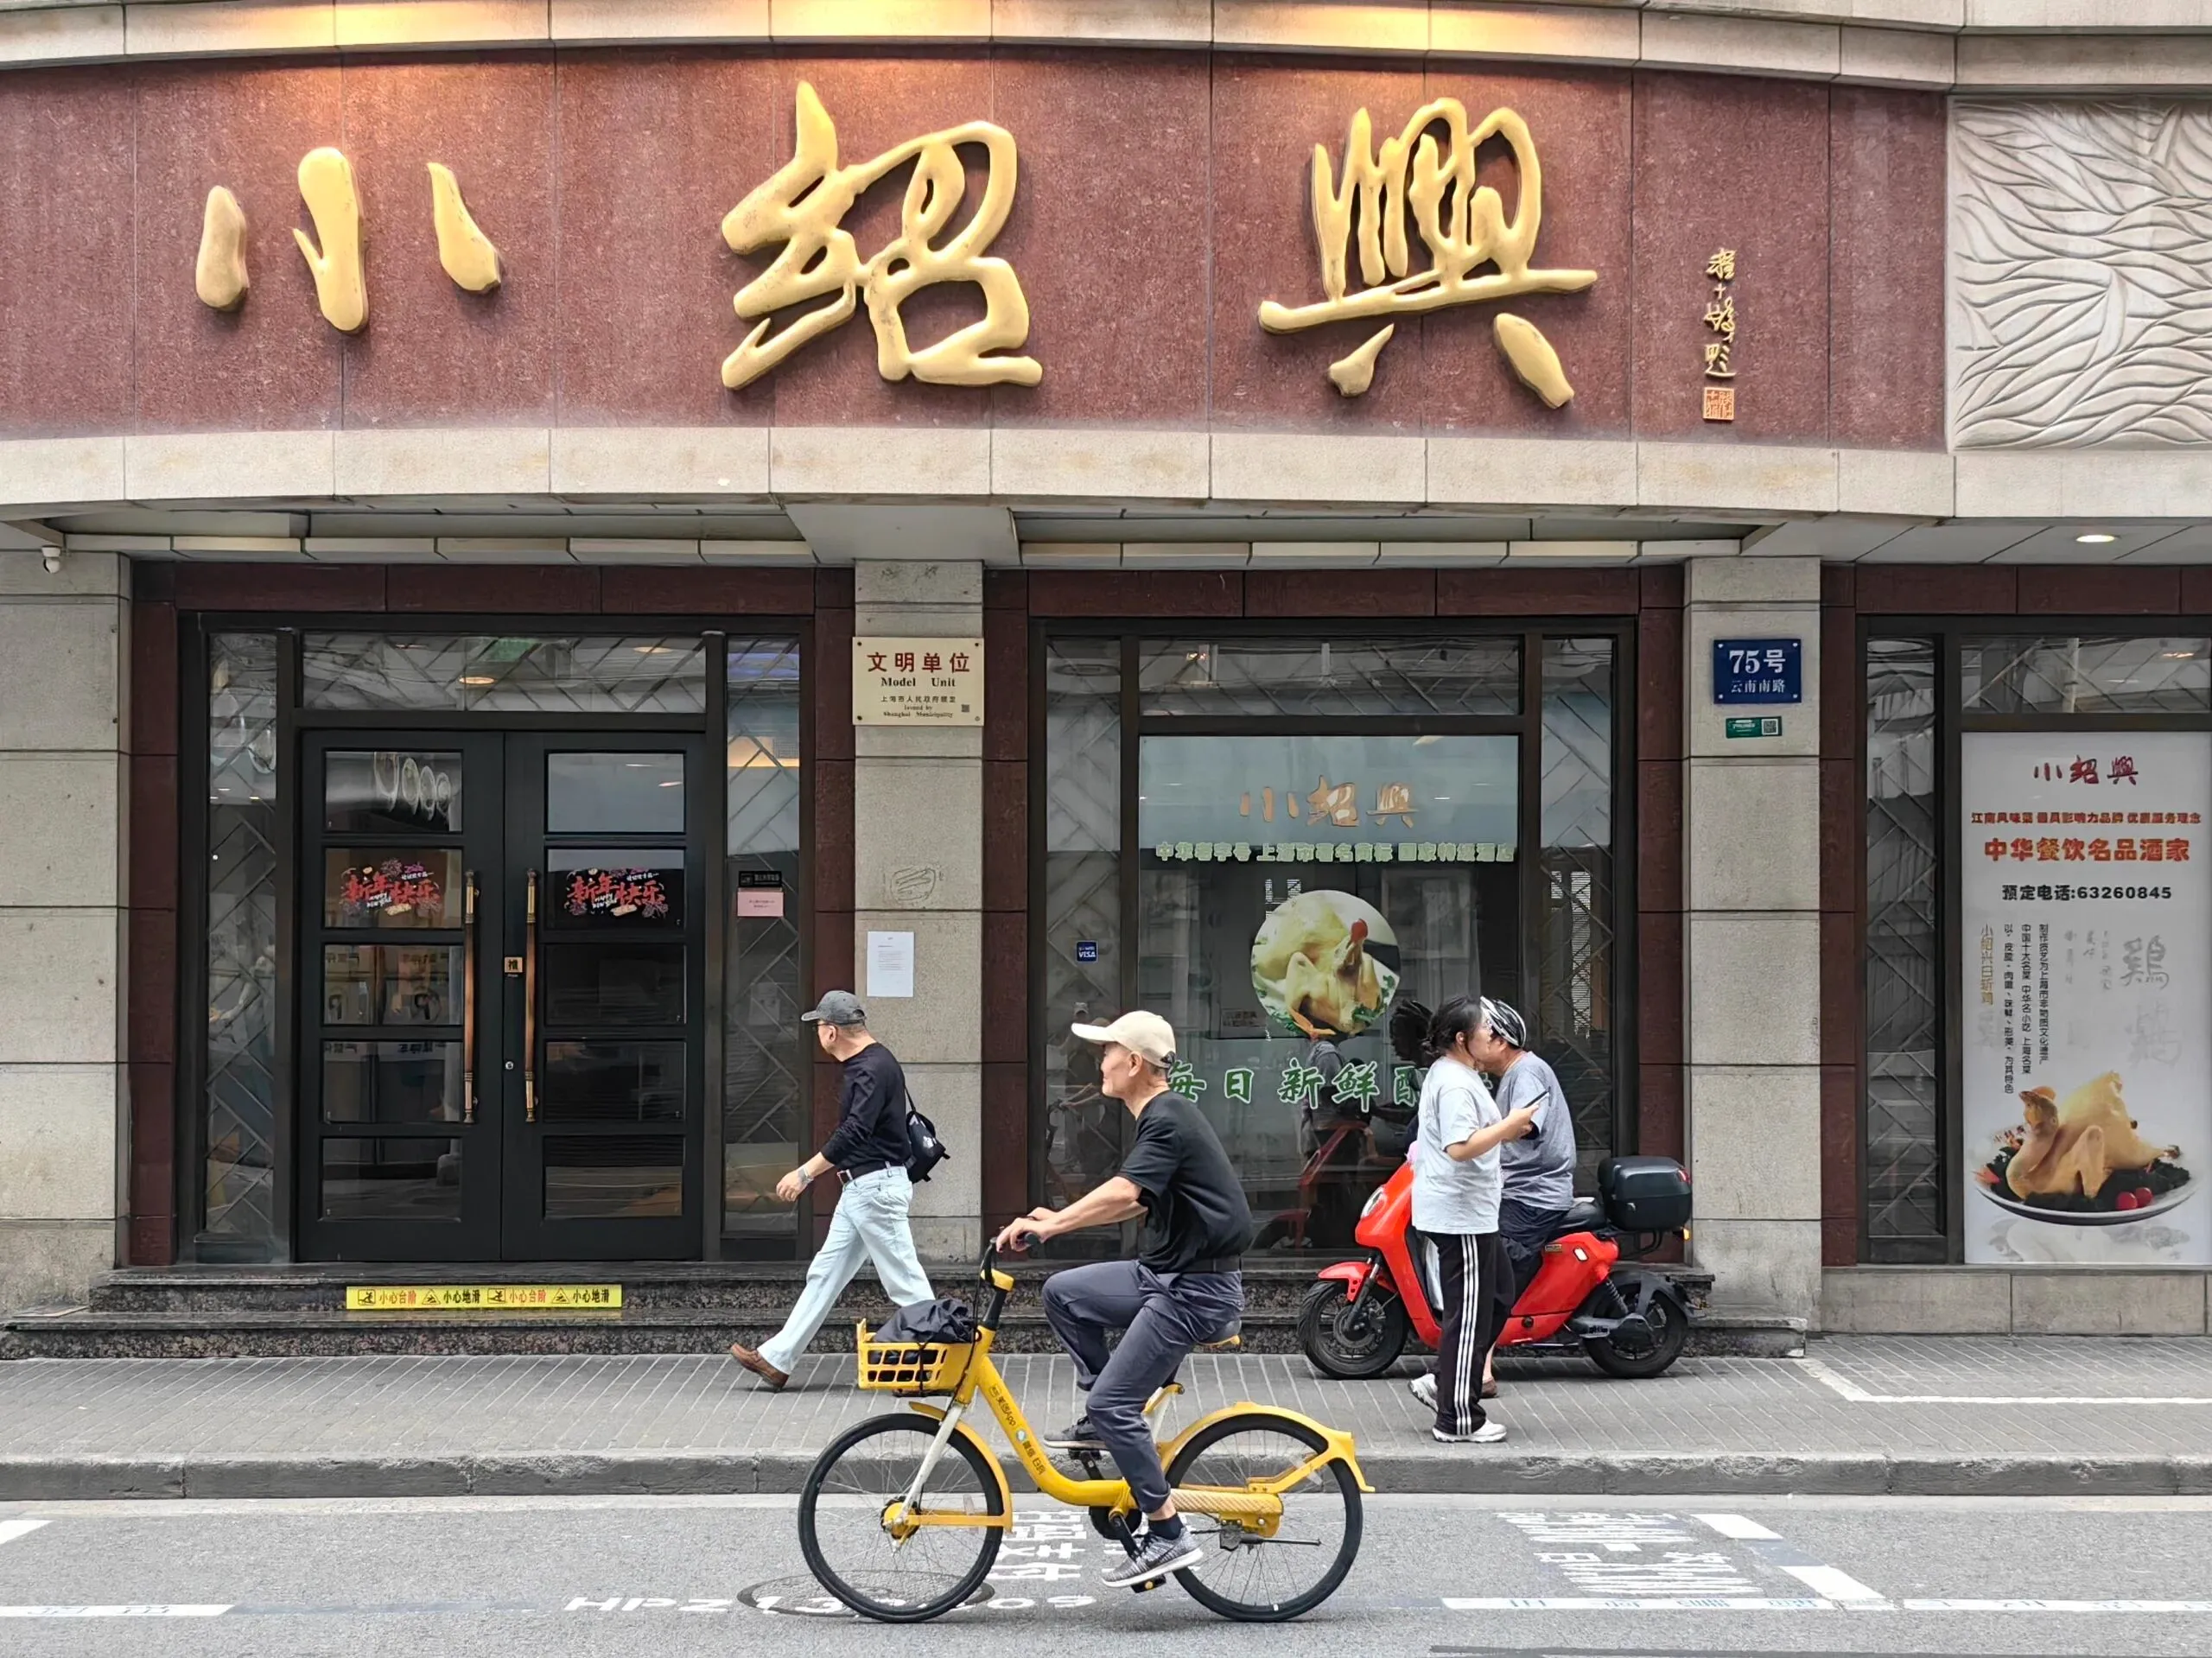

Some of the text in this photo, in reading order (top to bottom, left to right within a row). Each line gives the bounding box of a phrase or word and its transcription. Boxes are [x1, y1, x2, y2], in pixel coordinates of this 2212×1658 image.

[867, 651, 970, 673] 文明单位
[1728, 649, 1785, 673] 75号
[880, 677, 956, 687] Model Unit
[1731, 679, 1785, 693] 云南南路
[1155, 842, 1251, 861] 中华老字号
[1985, 837, 2190, 862] 中华餐饮名品酒家
[344, 873, 438, 905] 新年快乐
[569, 873, 665, 905] 新年快乐
[2002, 884, 2172, 901] 预定电话:63260845
[378, 1289, 609, 1304] 小心台阶 小心地滑 小心台阶 小心地滑
